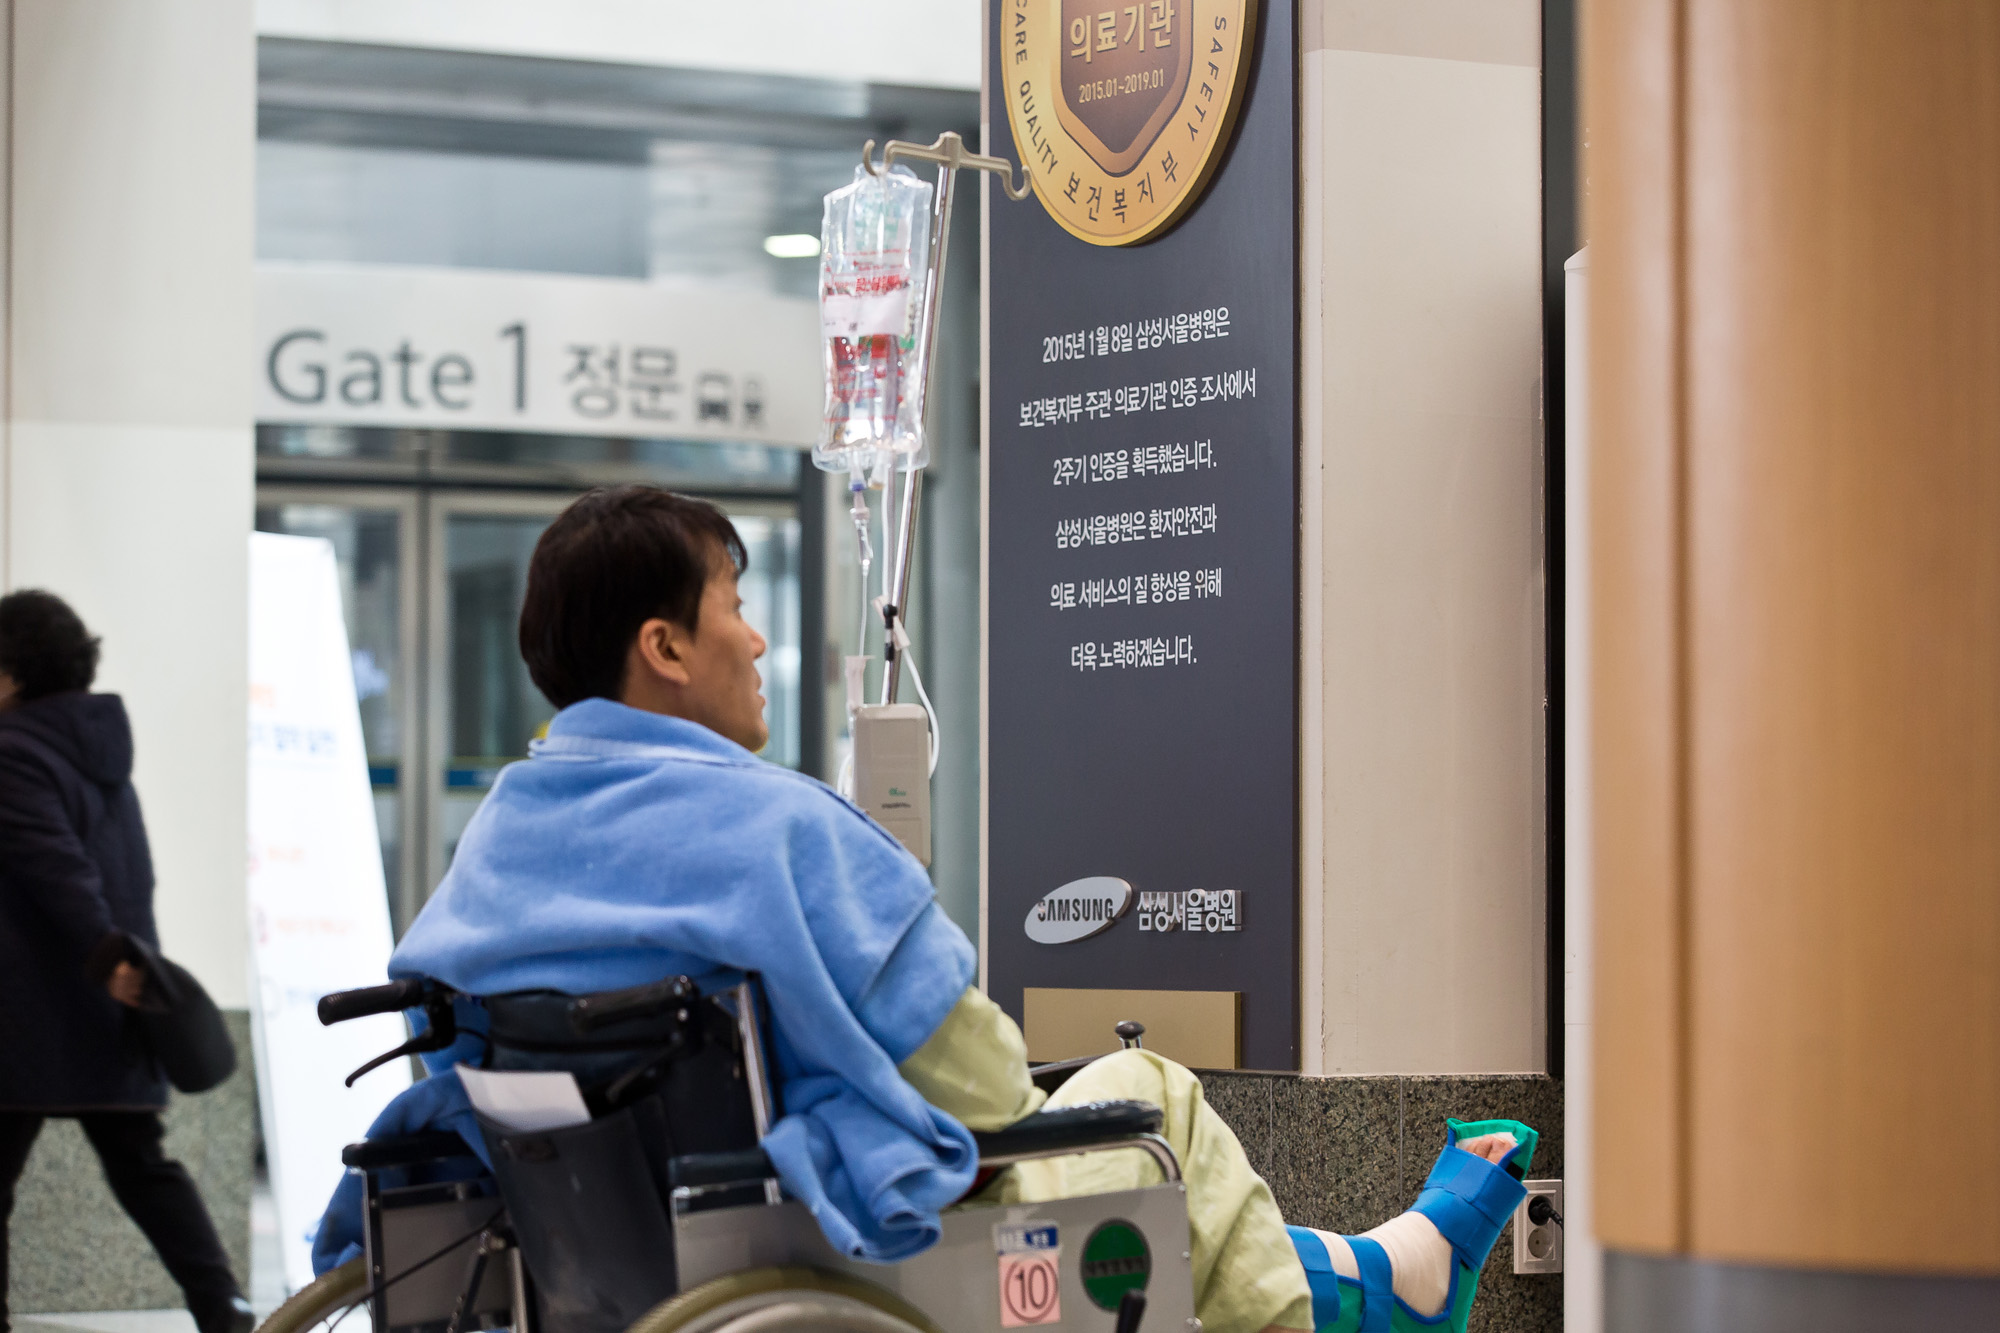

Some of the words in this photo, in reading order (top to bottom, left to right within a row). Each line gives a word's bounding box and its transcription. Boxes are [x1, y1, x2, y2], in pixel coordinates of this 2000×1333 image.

[1069, 0, 1176, 63] 의료기관
[1078, 68, 1164, 103] 2015.01~2019.01
[1187, 16, 1227, 141] SAFETY
[1019, 80, 1058, 174] QUALITY
[1063, 150, 1178, 223] 보건복지부
[1042, 330, 1085, 363] 2015년
[1088, 326, 1109, 356] 1월
[1111, 322, 1132, 353] 8일
[1135, 306, 1230, 350] 삼성서울병원은
[266, 329, 476, 410] Gate
[499, 321, 530, 413] 1
[564, 342, 680, 421] 정문
[1019, 393, 1083, 427] 보건복지부
[1085, 388, 1112, 420] 주관
[1114, 381, 1168, 415] 의료기관
[1170, 377, 1198, 408] 인증
[1200, 367, 1256, 401] 조사에서
[1053, 455, 1087, 485] 2주기
[1090, 449, 1128, 482] 인증을
[1132, 439, 1217, 476] 획득했습니다.
[1055, 510, 1146, 549] 삼성서울병원은
[1149, 503, 1217, 539] 환자안전과
[1050, 582, 1076, 611] 의료
[1078, 575, 1131, 608] 서비스의
[1134, 574, 1148, 604] 질
[1151, 570, 1191, 603] 향상을
[1194, 567, 1222, 598] 위해
[1071, 642, 1097, 672] 더욱
[1099, 635, 1197, 669] 노력하겠습니다.
[1037, 898, 1114, 922] SAMSUNG
[1137, 888, 1239, 933] 삼성서울병원
[1014, 1264, 1049, 1311] 10
